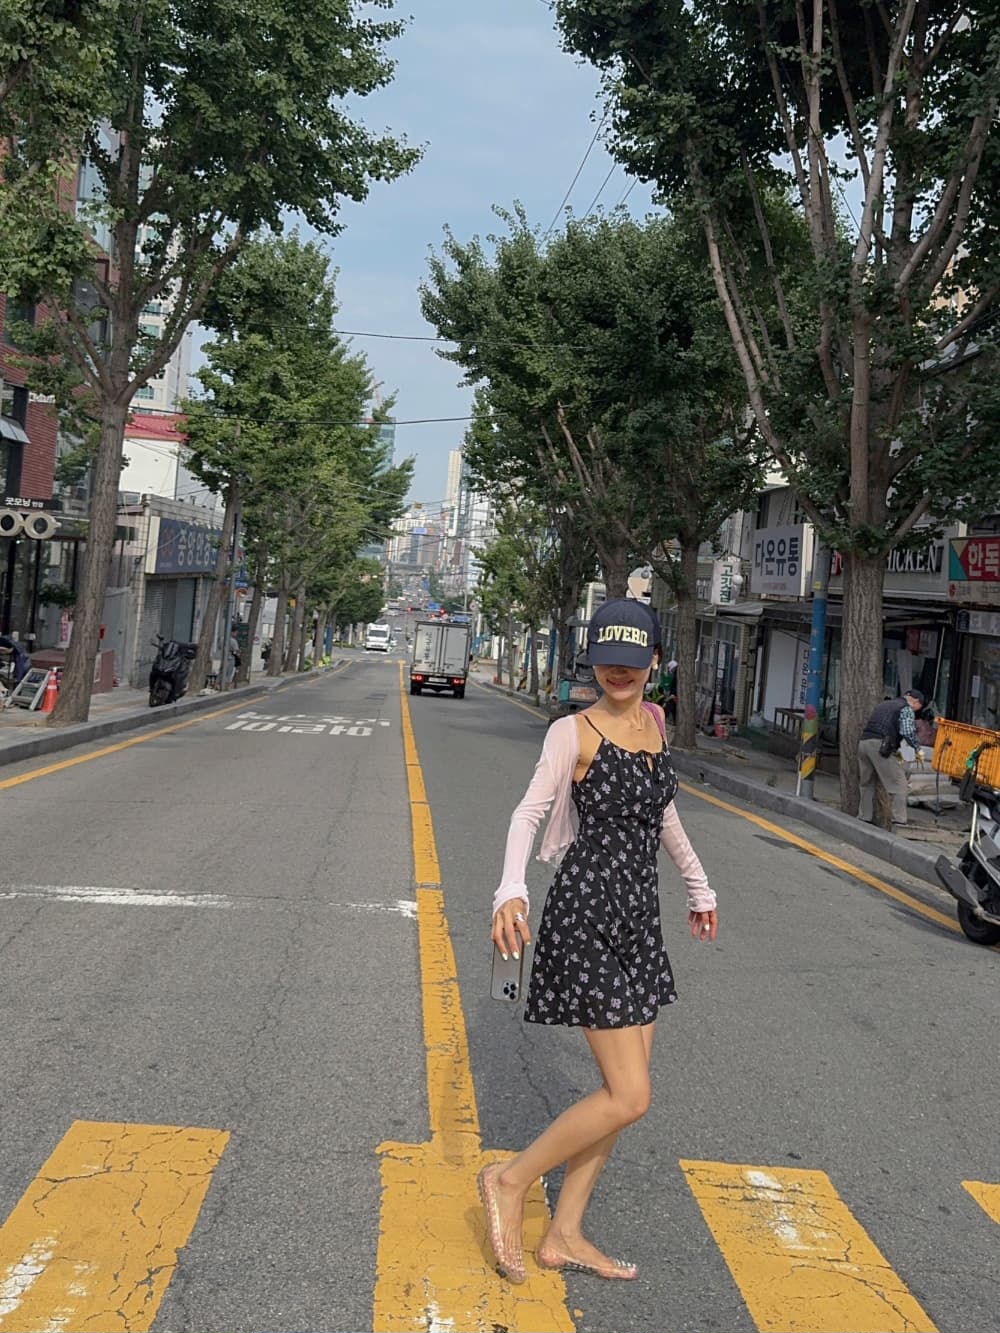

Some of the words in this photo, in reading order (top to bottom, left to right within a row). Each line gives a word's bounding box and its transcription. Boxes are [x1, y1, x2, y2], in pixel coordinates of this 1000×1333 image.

[4, 497, 31, 507] 굿모닝
[755, 537, 800, 577] 다온유통
[967, 543, 1000, 577] 한독
[720, 564, 733, 603] 고깃집
[597, 625, 648, 647] LOVERO
